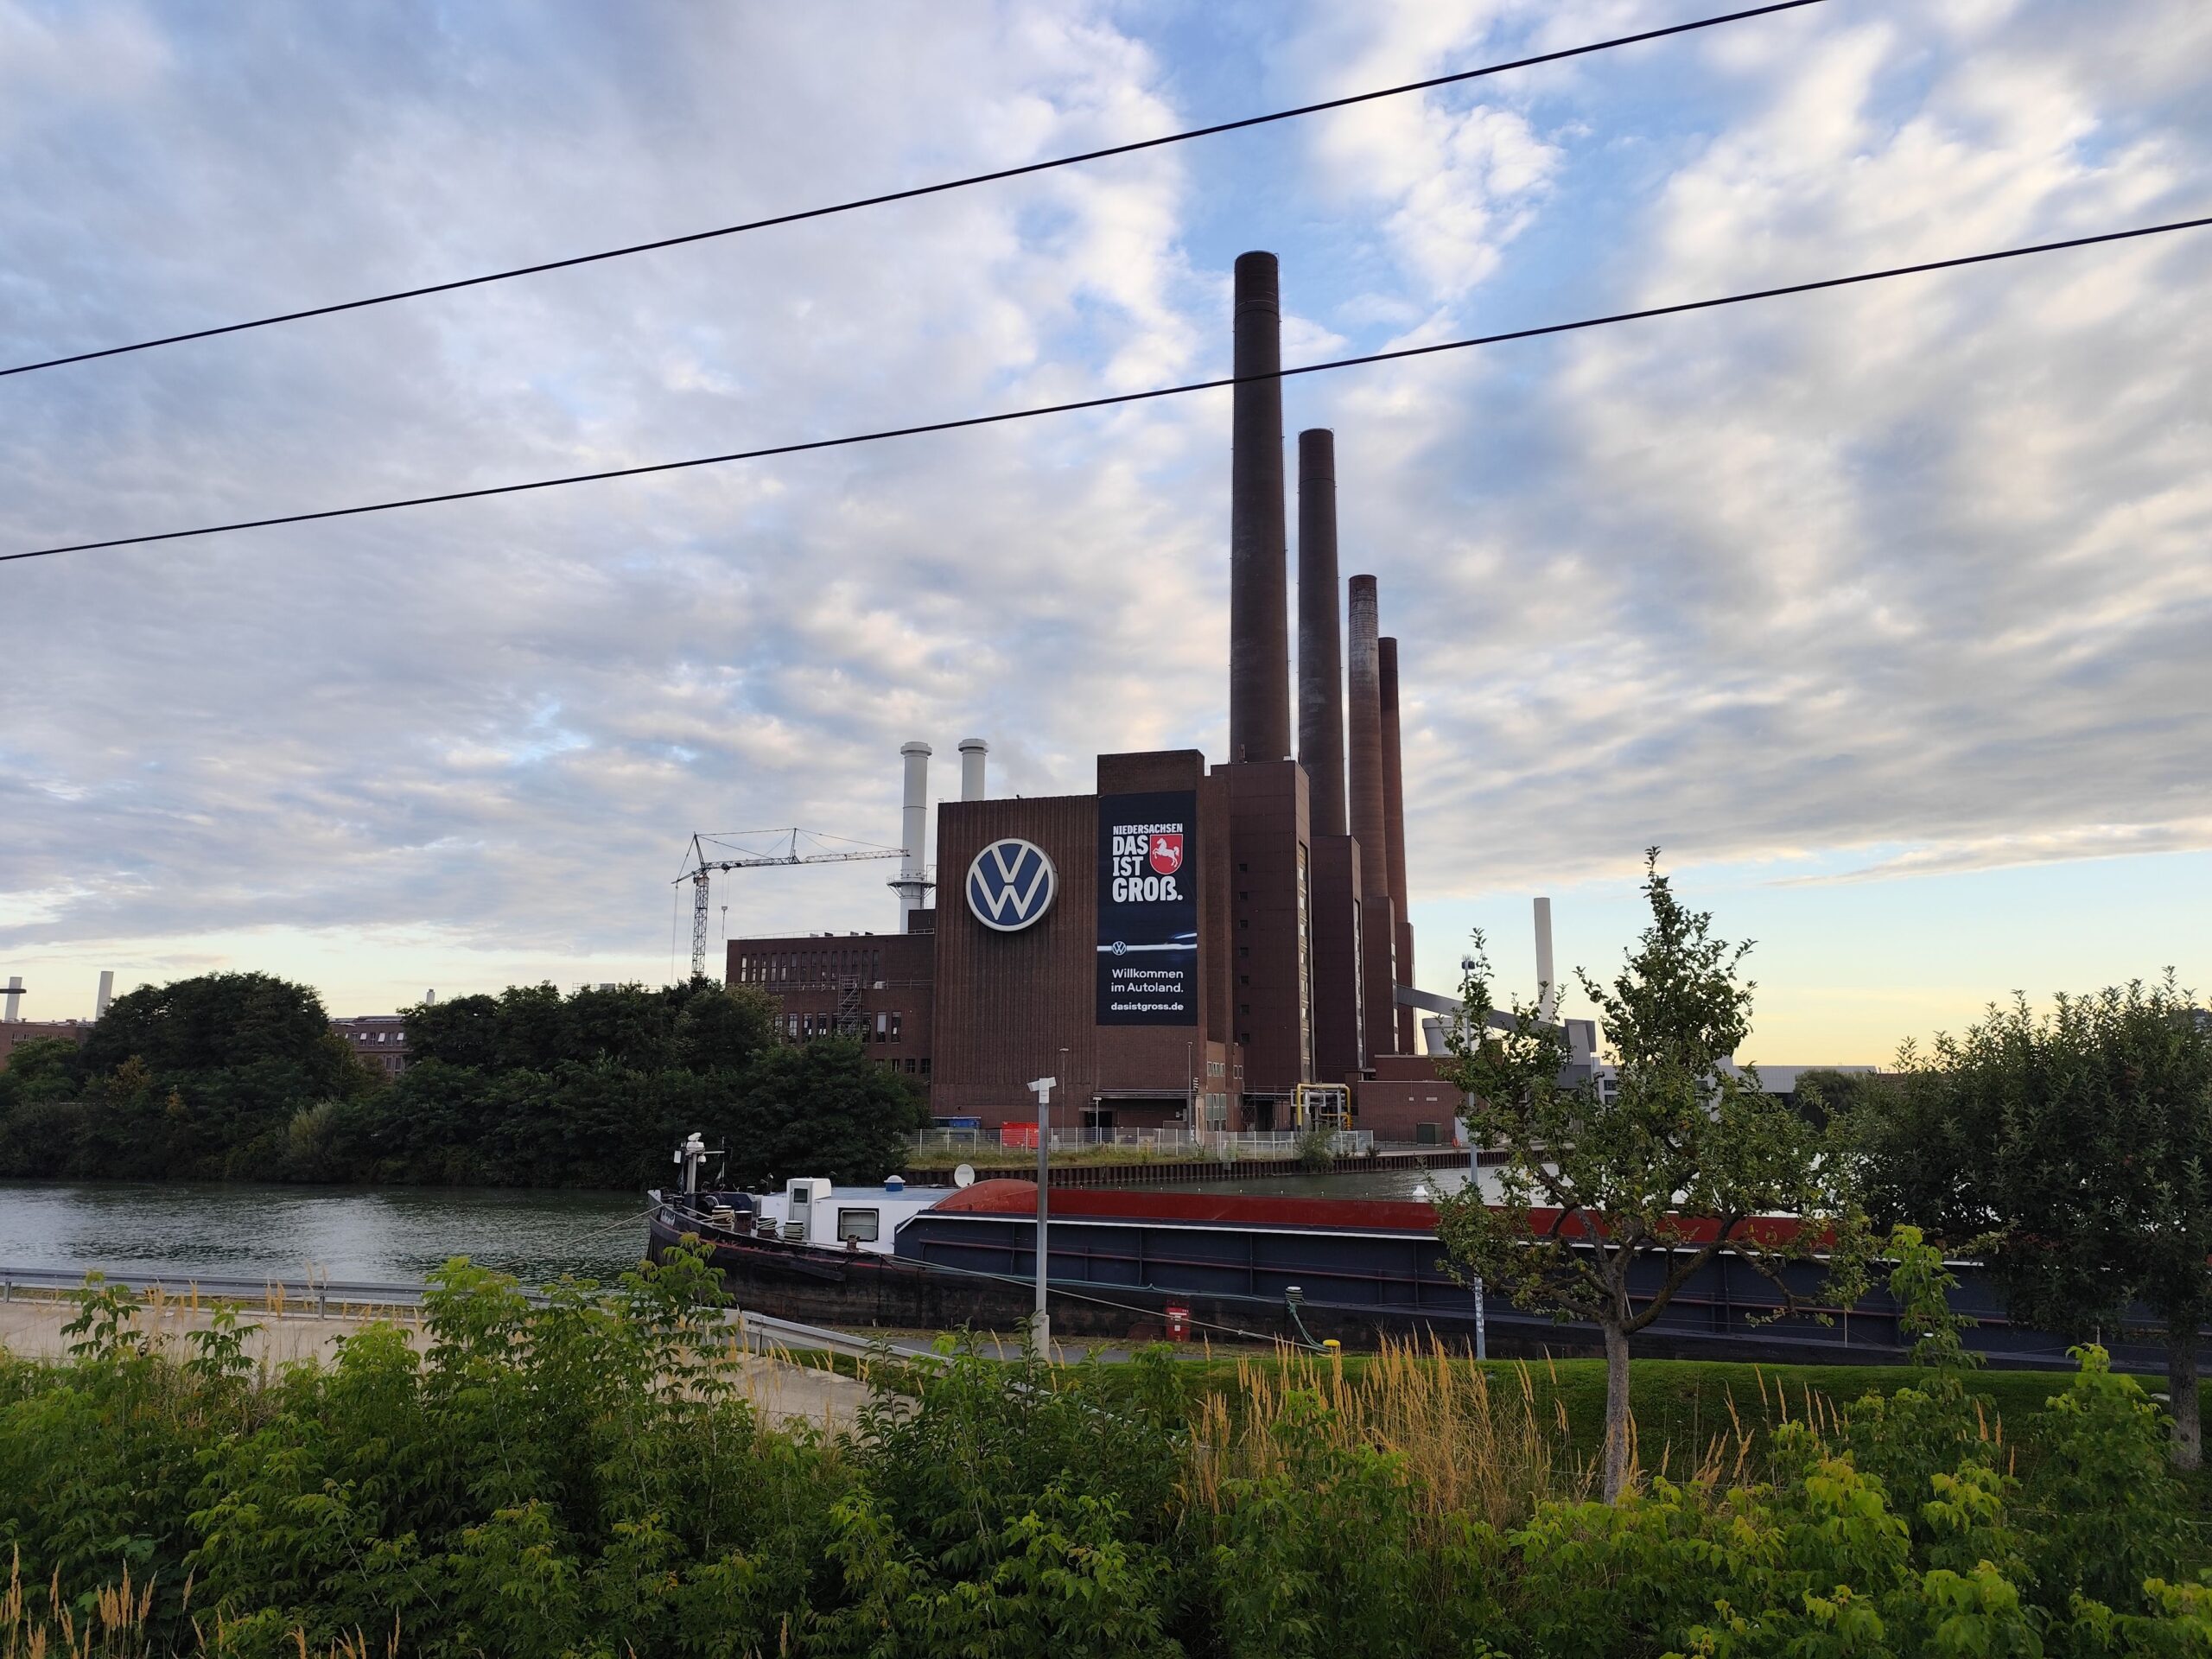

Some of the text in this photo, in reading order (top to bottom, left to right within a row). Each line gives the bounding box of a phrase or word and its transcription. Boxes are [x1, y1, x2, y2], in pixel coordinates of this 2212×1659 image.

[1113, 823, 1183, 836] NIEDERSACHSEN
[1113, 835, 1149, 855] DAS
[1113, 856, 1144, 876] IST
[1112, 968, 1184, 979] Willkommen
[1111, 982, 1184, 993] im Autoland.
[1111, 1002, 1184, 1012] dasistgross.de
